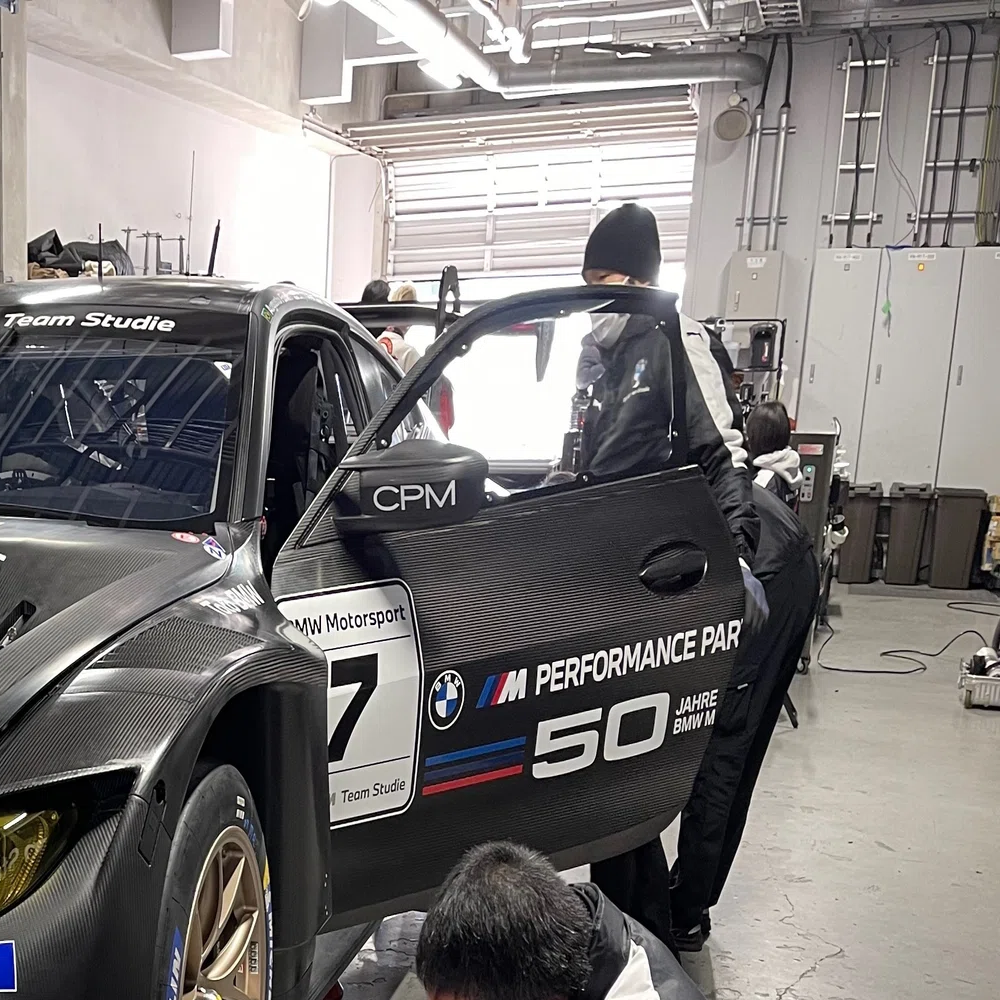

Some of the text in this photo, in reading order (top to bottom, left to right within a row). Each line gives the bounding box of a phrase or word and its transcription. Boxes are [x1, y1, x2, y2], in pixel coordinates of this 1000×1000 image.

[4, 312, 75, 328] Team
[81, 312, 176, 332] Studie
[373, 480, 456, 513] CPM
[290, 604, 406, 637] MW Motorsport
[535, 629, 697, 697] PERFORMANCE
[700, 618, 744, 657] PAR
[327, 652, 379, 763] 7
[675, 688, 719, 716] JAHRE
[532, 692, 671, 779] 50
[672, 708, 716, 735] BMW M
[341, 788, 370, 804] Team
[372, 778, 406, 797] Studie
